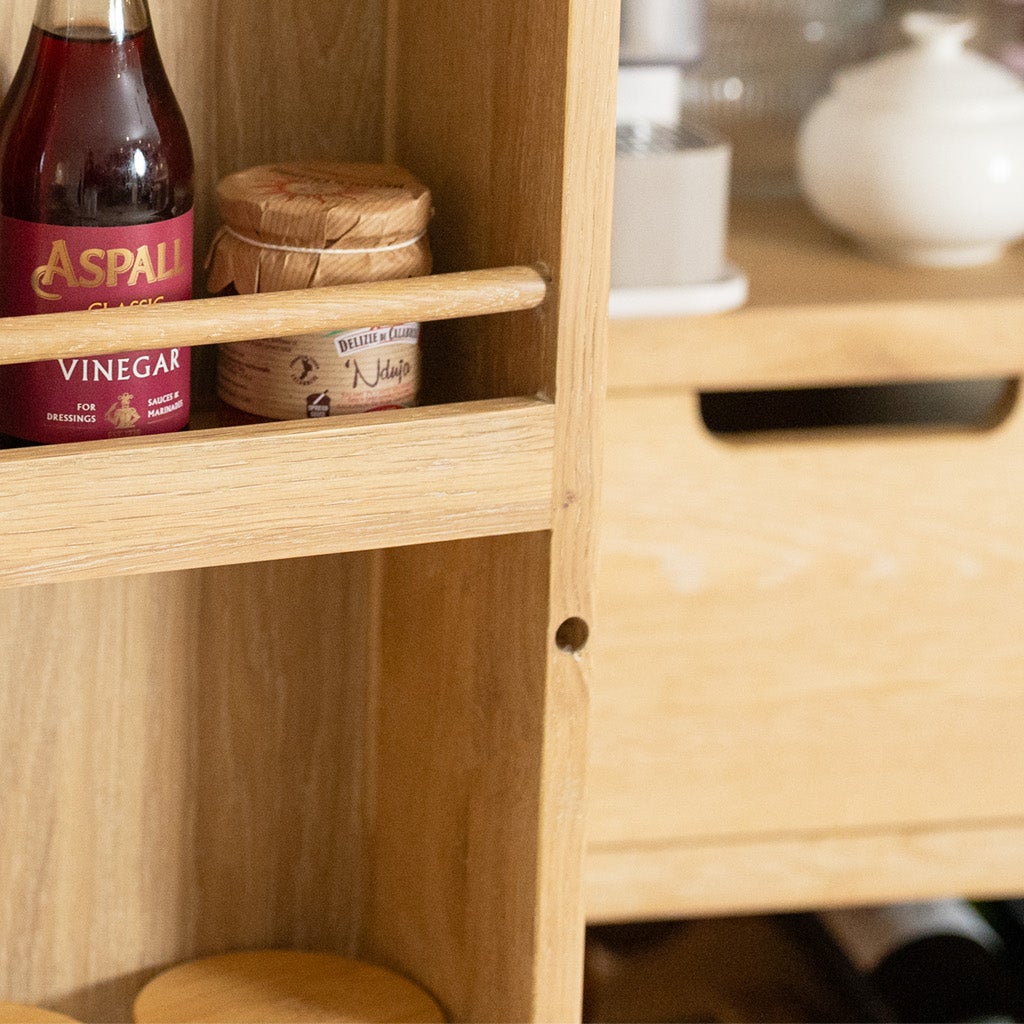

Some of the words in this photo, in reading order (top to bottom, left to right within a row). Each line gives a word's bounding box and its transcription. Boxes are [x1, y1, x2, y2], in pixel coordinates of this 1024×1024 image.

[30, 239, 185, 301] ASPALL
[338, 332, 378, 353] DELIZIE
[58, 348, 180, 382] VINEGAR
[77, 403, 96, 412] FOR
[147, 392, 173, 407] SAUCES
[47, 412, 96, 423] DRESSINGS
